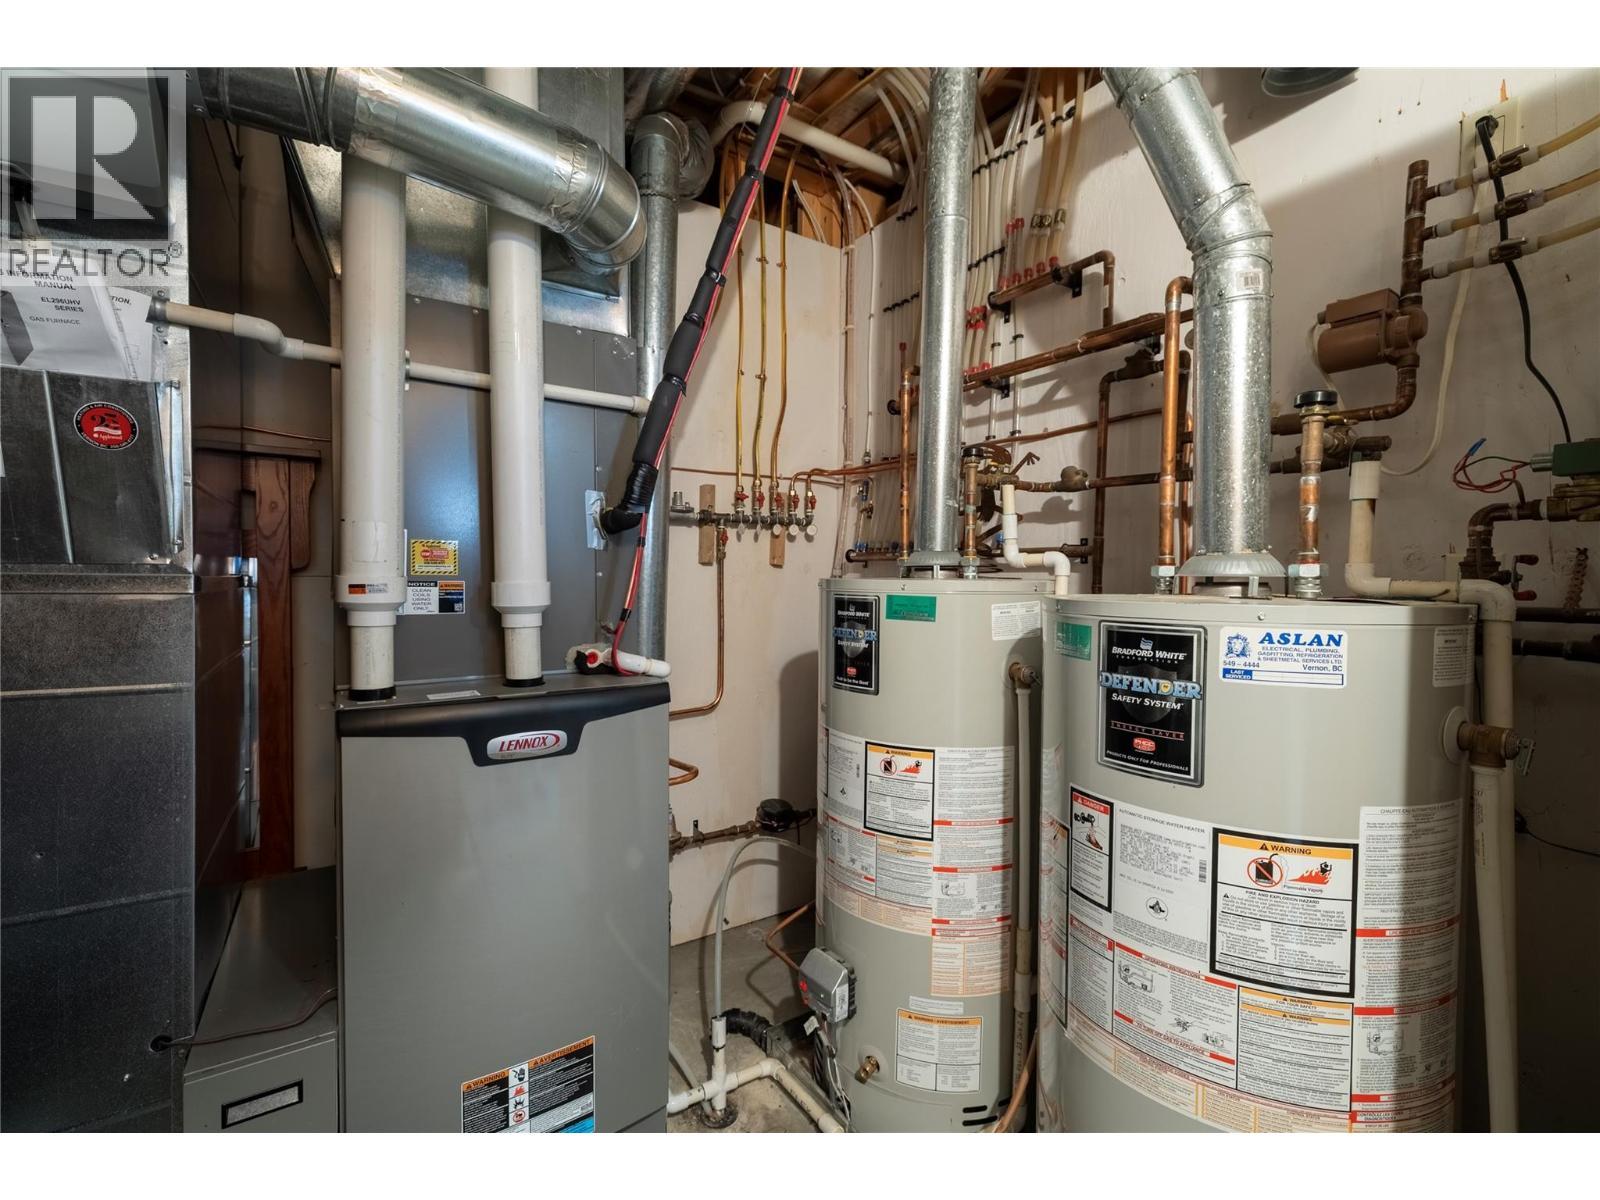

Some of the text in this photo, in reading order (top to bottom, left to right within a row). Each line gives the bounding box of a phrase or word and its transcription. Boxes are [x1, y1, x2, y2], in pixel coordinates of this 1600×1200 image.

[6, 269, 74, 282] INFORMATION
[33, 280, 77, 291] MANUAL
[40, 296, 81, 306] EL296UHV
[54, 304, 84, 313] SERIES
[46, 316, 81, 326] FURNACE
[832, 626, 878, 642] DEFENDER
[1258, 632, 1344, 647] ASLAN
[1112, 646, 1154, 658] BRADFORD
[1302, 664, 1330, 672] Vernon,
[1100, 671, 1202, 700] DEFENDER
[1112, 692, 1142, 705] SAFETY
[1152, 729, 1184, 739] SAVER
[498, 736, 550, 752] LENNOX
[1106, 750, 1127, 759] PRODUCTS
[1150, 760, 1189, 771] PROFESSIONALS
[1270, 844, 1312, 856] WARNING
[1270, 894, 1298, 902] EXPLOSION
[538, 1040, 591, 1066] AVERTISSEMENT
[472, 1072, 506, 1088] WARNING
